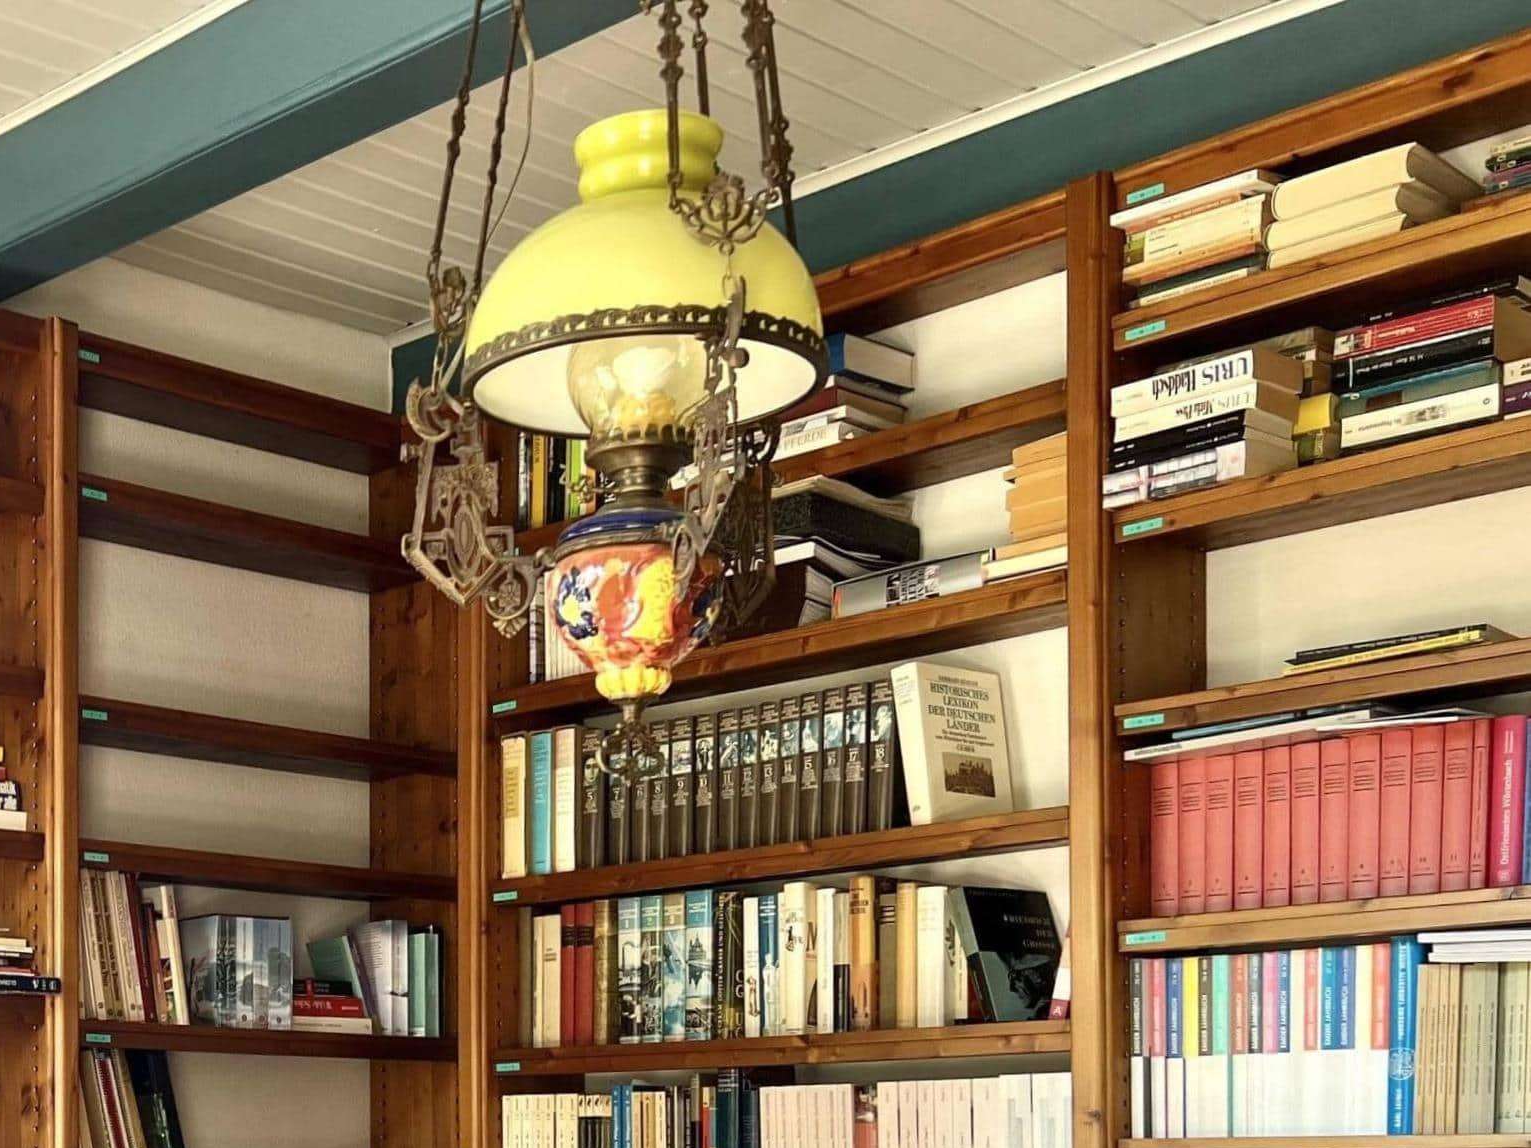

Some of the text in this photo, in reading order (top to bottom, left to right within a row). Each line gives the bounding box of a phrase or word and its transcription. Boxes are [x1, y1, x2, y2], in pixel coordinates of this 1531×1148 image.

[1201, 357, 1248, 386] URIS
[930, 682, 989, 700] HISTORISCHES
[943, 696, 979, 709] LEXIKON
[927, 704, 996, 723] DER DEUTSCHEN
